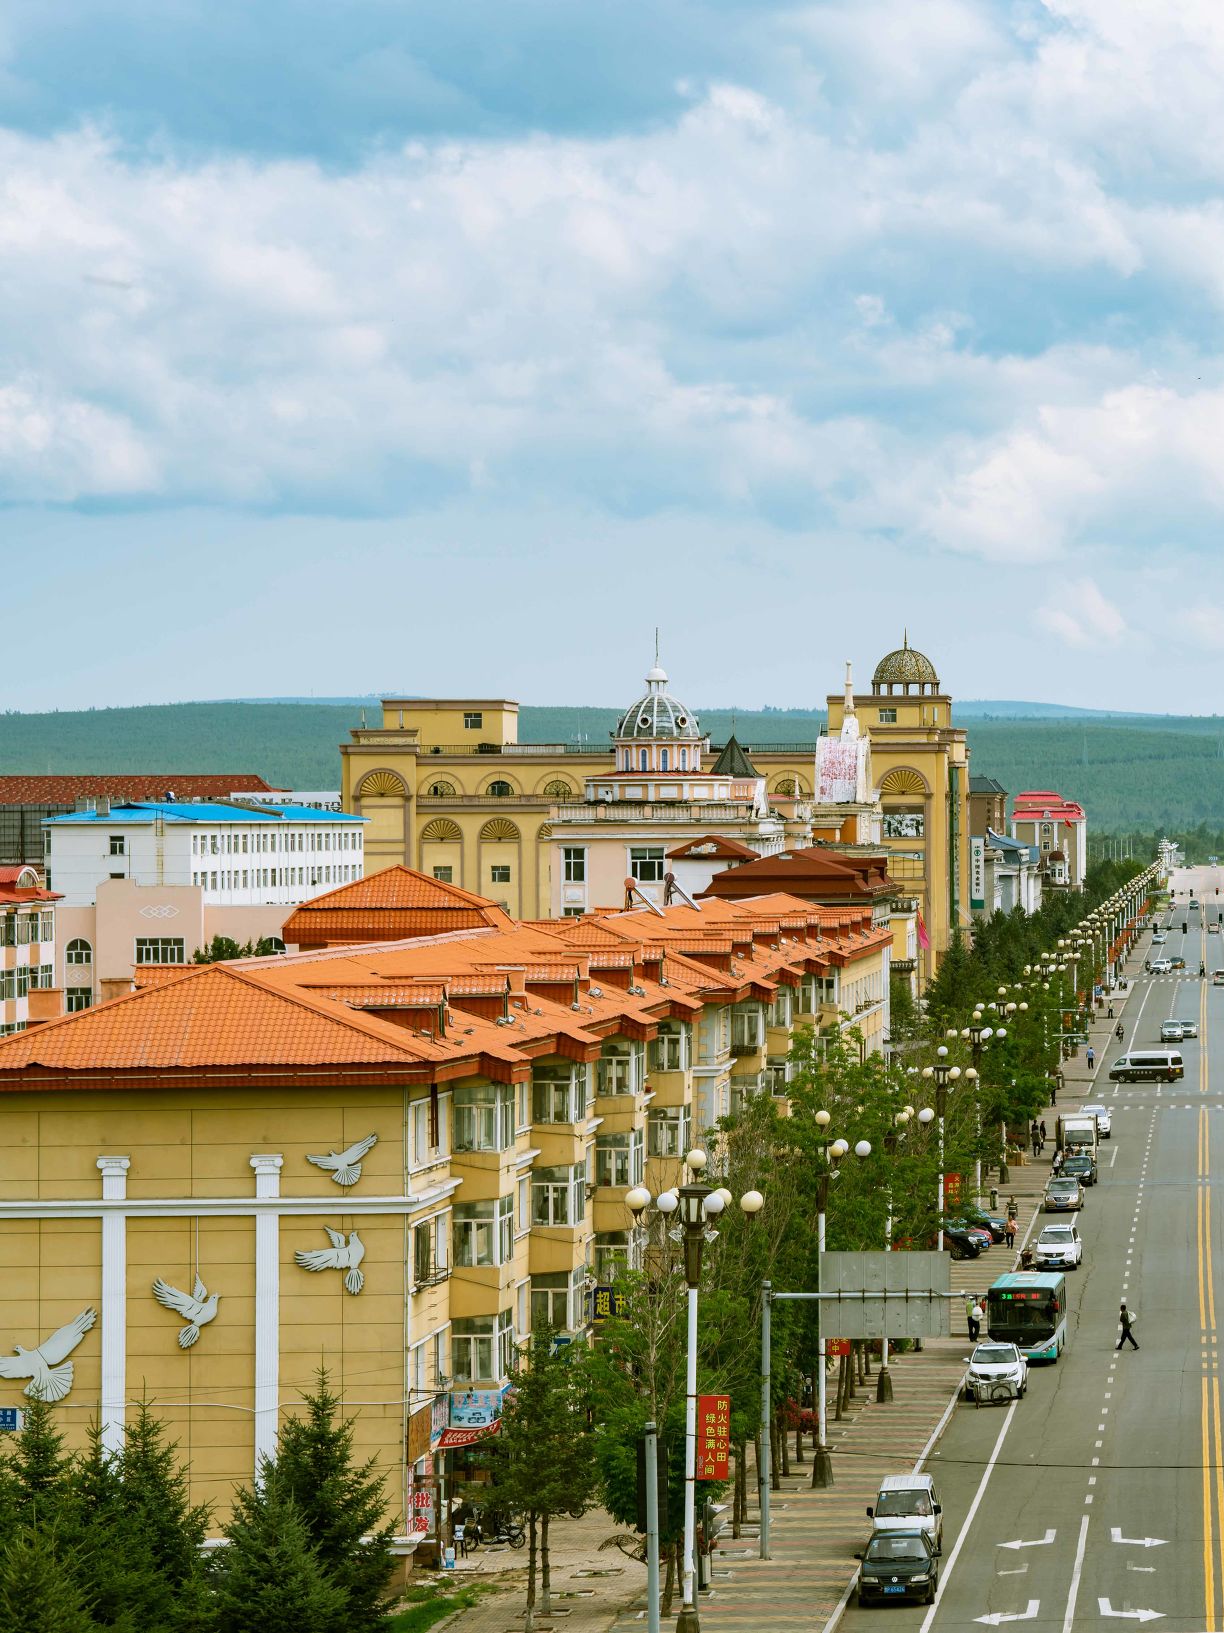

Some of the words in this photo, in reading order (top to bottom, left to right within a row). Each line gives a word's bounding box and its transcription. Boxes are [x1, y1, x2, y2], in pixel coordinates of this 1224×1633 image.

[596, 1291, 626, 1316] 超市
[704, 1413, 716, 1476] 绿色满人间
[716, 1401, 728, 1462] 防火驻心田
[415, 1492, 430, 1533] 批发
